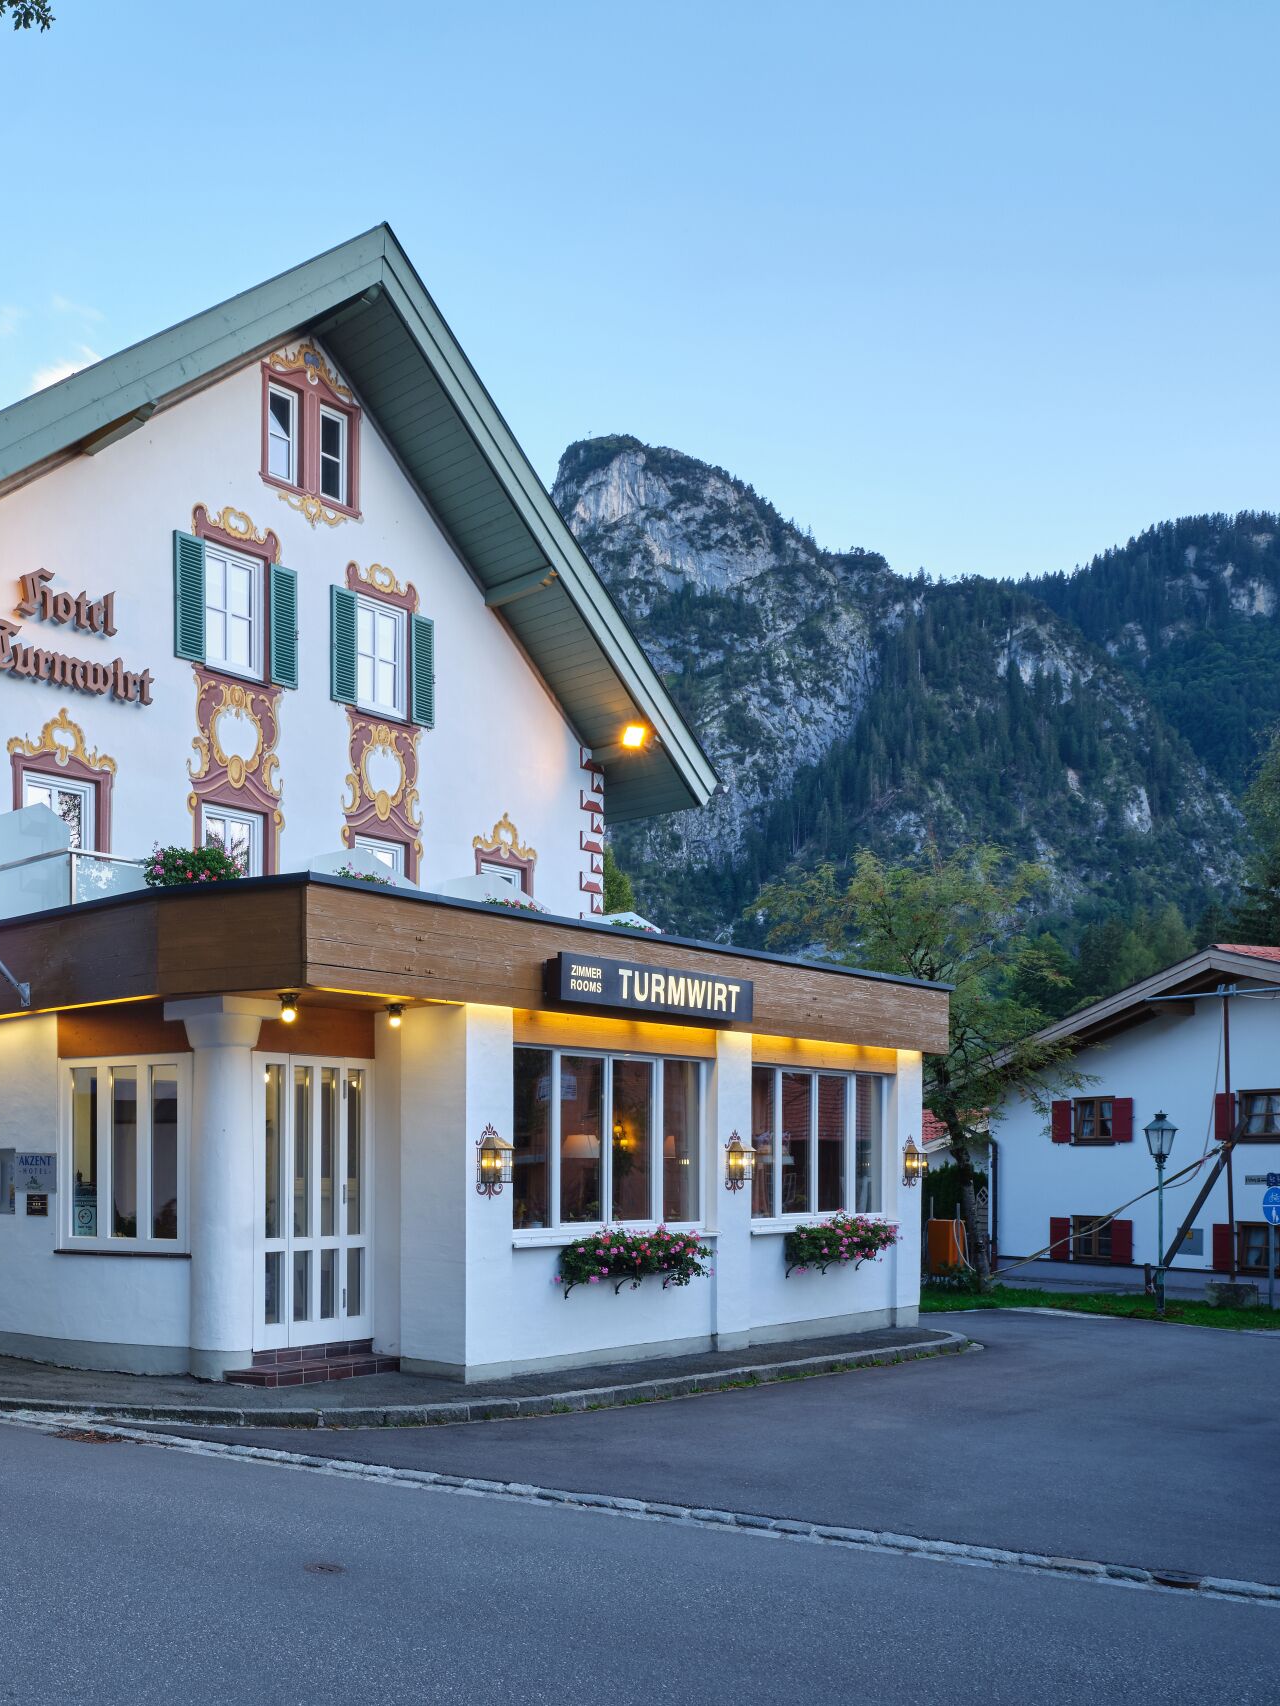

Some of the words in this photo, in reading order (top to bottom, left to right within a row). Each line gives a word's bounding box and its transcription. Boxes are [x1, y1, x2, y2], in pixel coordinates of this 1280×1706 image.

[14, 568, 118, 637] Hotel
[571, 964, 602, 979] ZIMMER
[570, 979, 602, 993] ROOMS
[618, 968, 741, 1013] TURMWIRT
[19, 1155, 51, 1166] AKZENT
[22, 1167, 49, 1175] HOTEL
